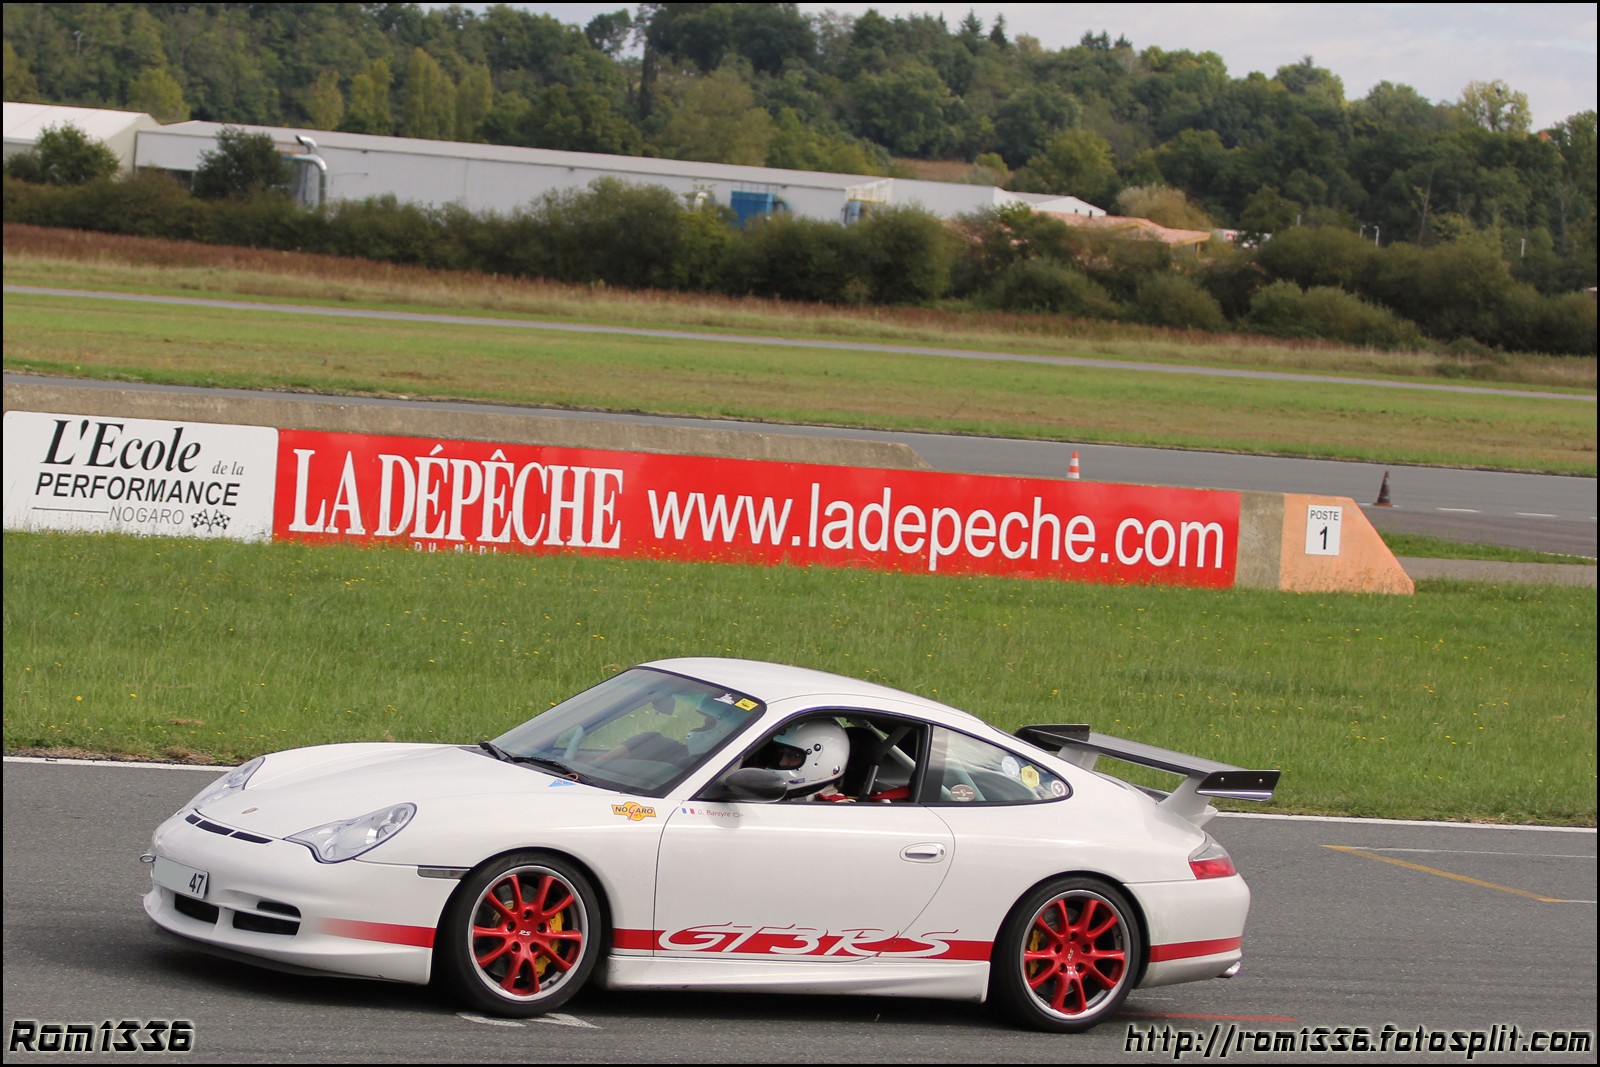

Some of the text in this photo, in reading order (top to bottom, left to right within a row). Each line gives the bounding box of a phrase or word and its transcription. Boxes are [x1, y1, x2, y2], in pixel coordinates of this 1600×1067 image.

[40, 419, 244, 476] L'Ecole de la
[35, 472, 241, 506] PERFORMANCE
[288, 443, 624, 550] LA DÉPÊCHE
[109, 506, 185, 525] NOGARO
[647, 482, 1224, 572] www.ladepeche.com
[1310, 509, 1340, 521] POSTE
[1319, 525, 1328, 551] 1
[614, 804, 654, 820] NOGARO
[189, 872, 205, 894] 47
